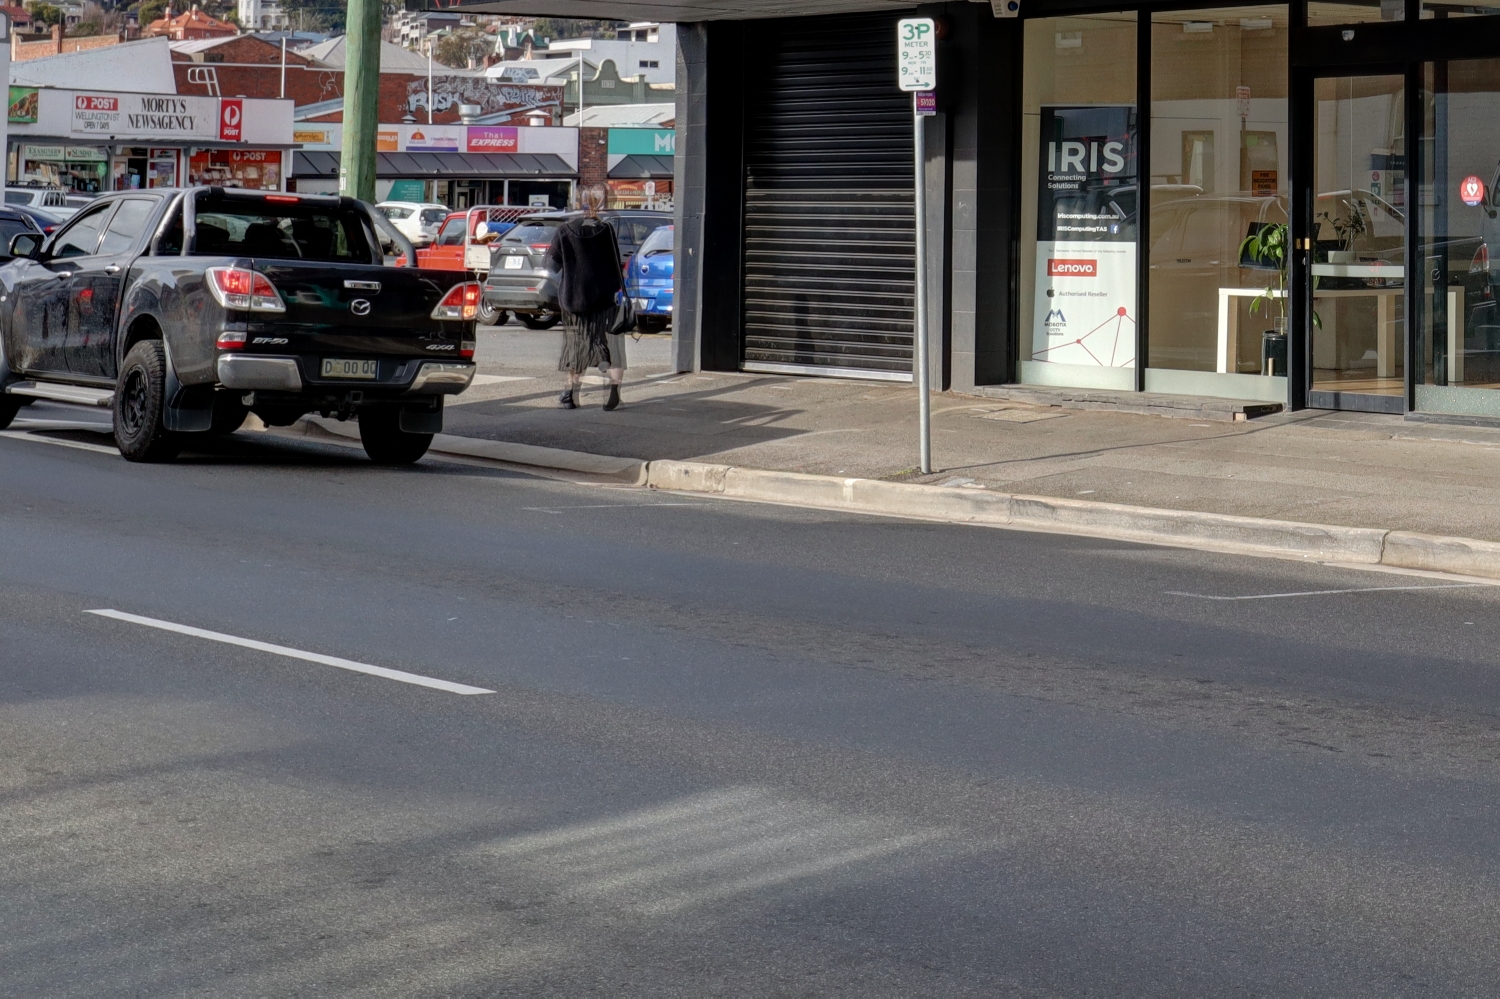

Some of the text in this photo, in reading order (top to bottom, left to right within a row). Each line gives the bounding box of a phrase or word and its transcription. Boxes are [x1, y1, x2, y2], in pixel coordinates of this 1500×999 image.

[902, 23, 931, 40] 3P
[901, 51, 909, 60] 9
[901, 66, 909, 76] 9
[91, 97, 187, 113] POST MORTY'S
[75, 111, 120, 121] WELLINGTON ST
[84, 121, 96, 129] OPEN
[100, 121, 110, 129] DAYS
[127, 113, 196, 130] NEWSAGENCY
[483, 131, 503, 139] Thai
[470, 139, 515, 147] EXPRESS
[243, 152, 267, 161] POST
[1047, 141, 1125, 173] IRIS
[1047, 174, 1087, 182] Connecting
[1051, 262, 1094, 273] Lenovo
